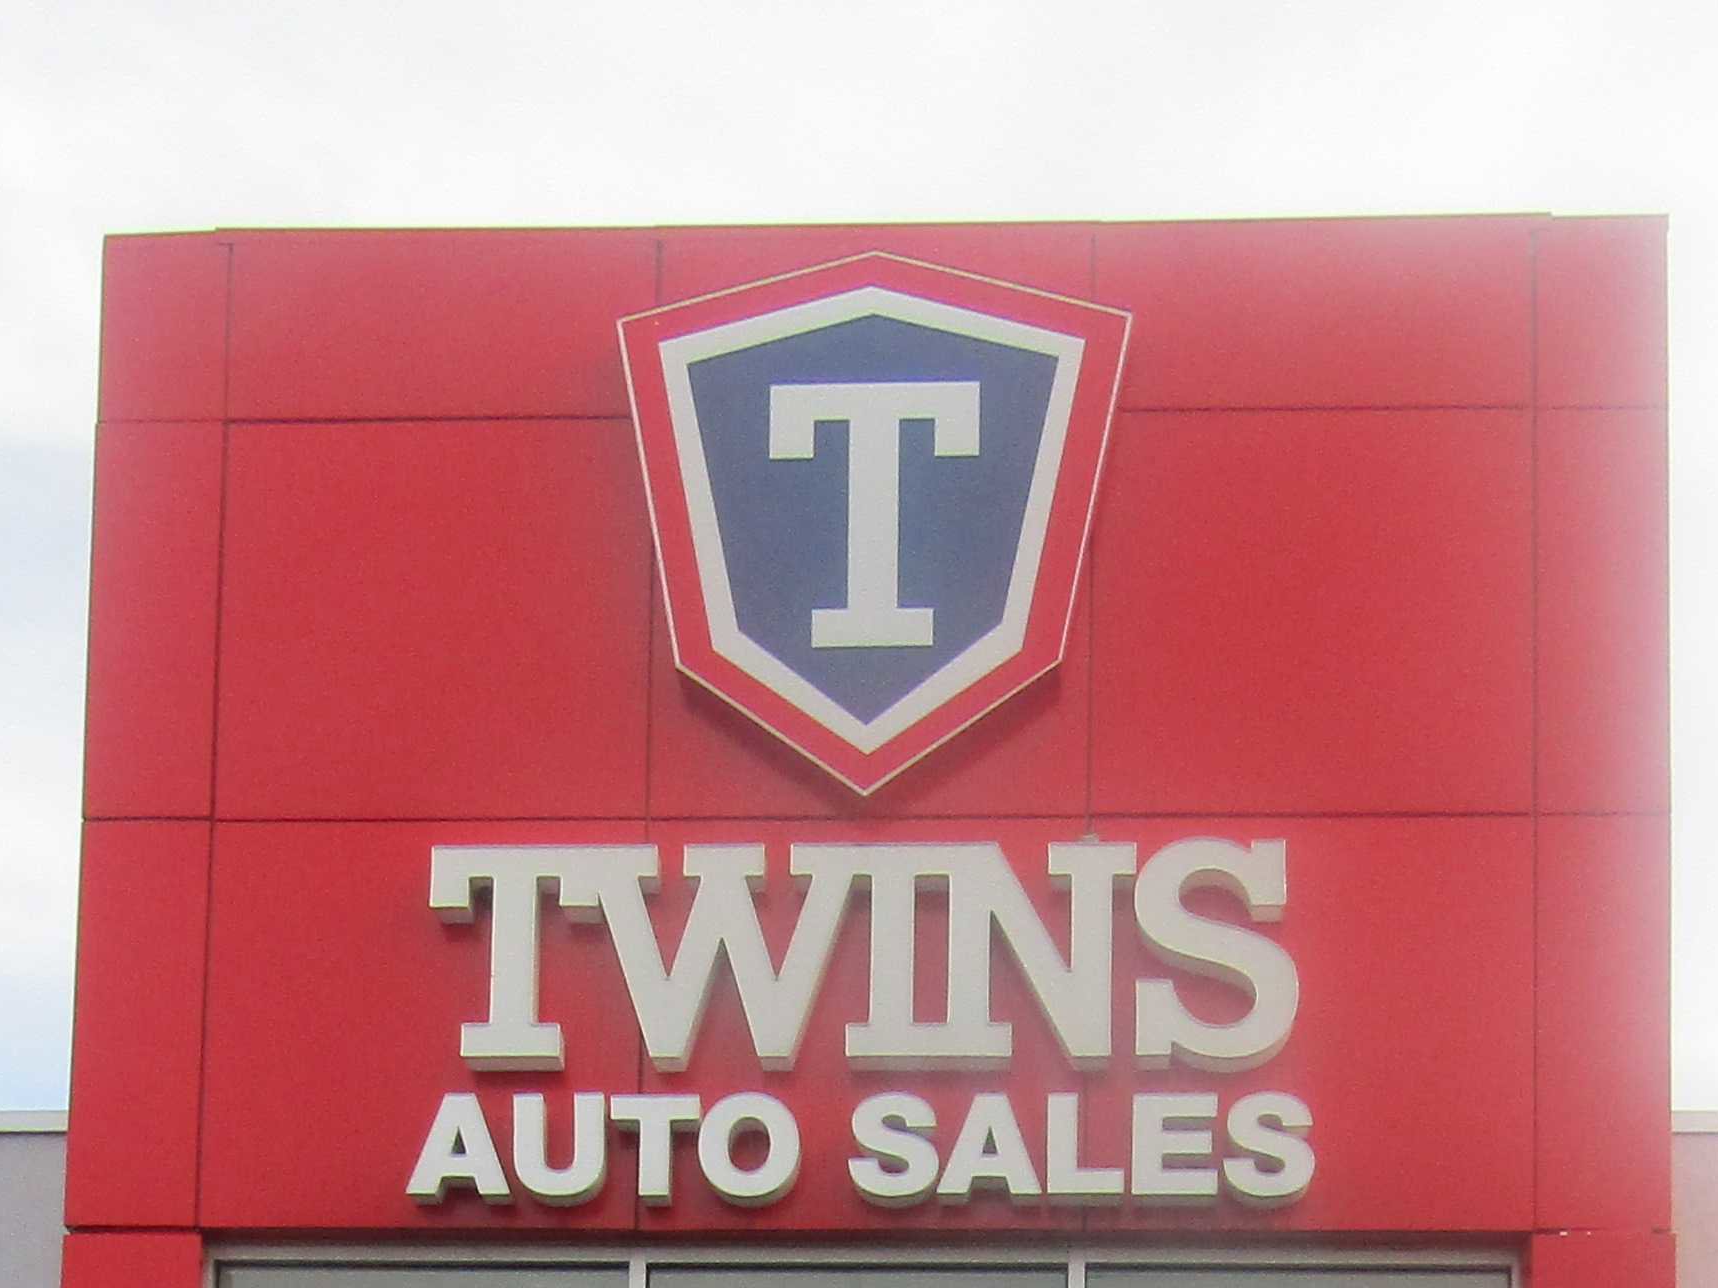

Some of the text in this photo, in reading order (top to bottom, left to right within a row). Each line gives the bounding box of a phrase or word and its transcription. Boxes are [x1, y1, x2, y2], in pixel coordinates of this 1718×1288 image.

[769, 380, 981, 649] T
[428, 836, 1300, 1072] TWINS
[405, 1091, 1317, 1207] AUTO SALES
